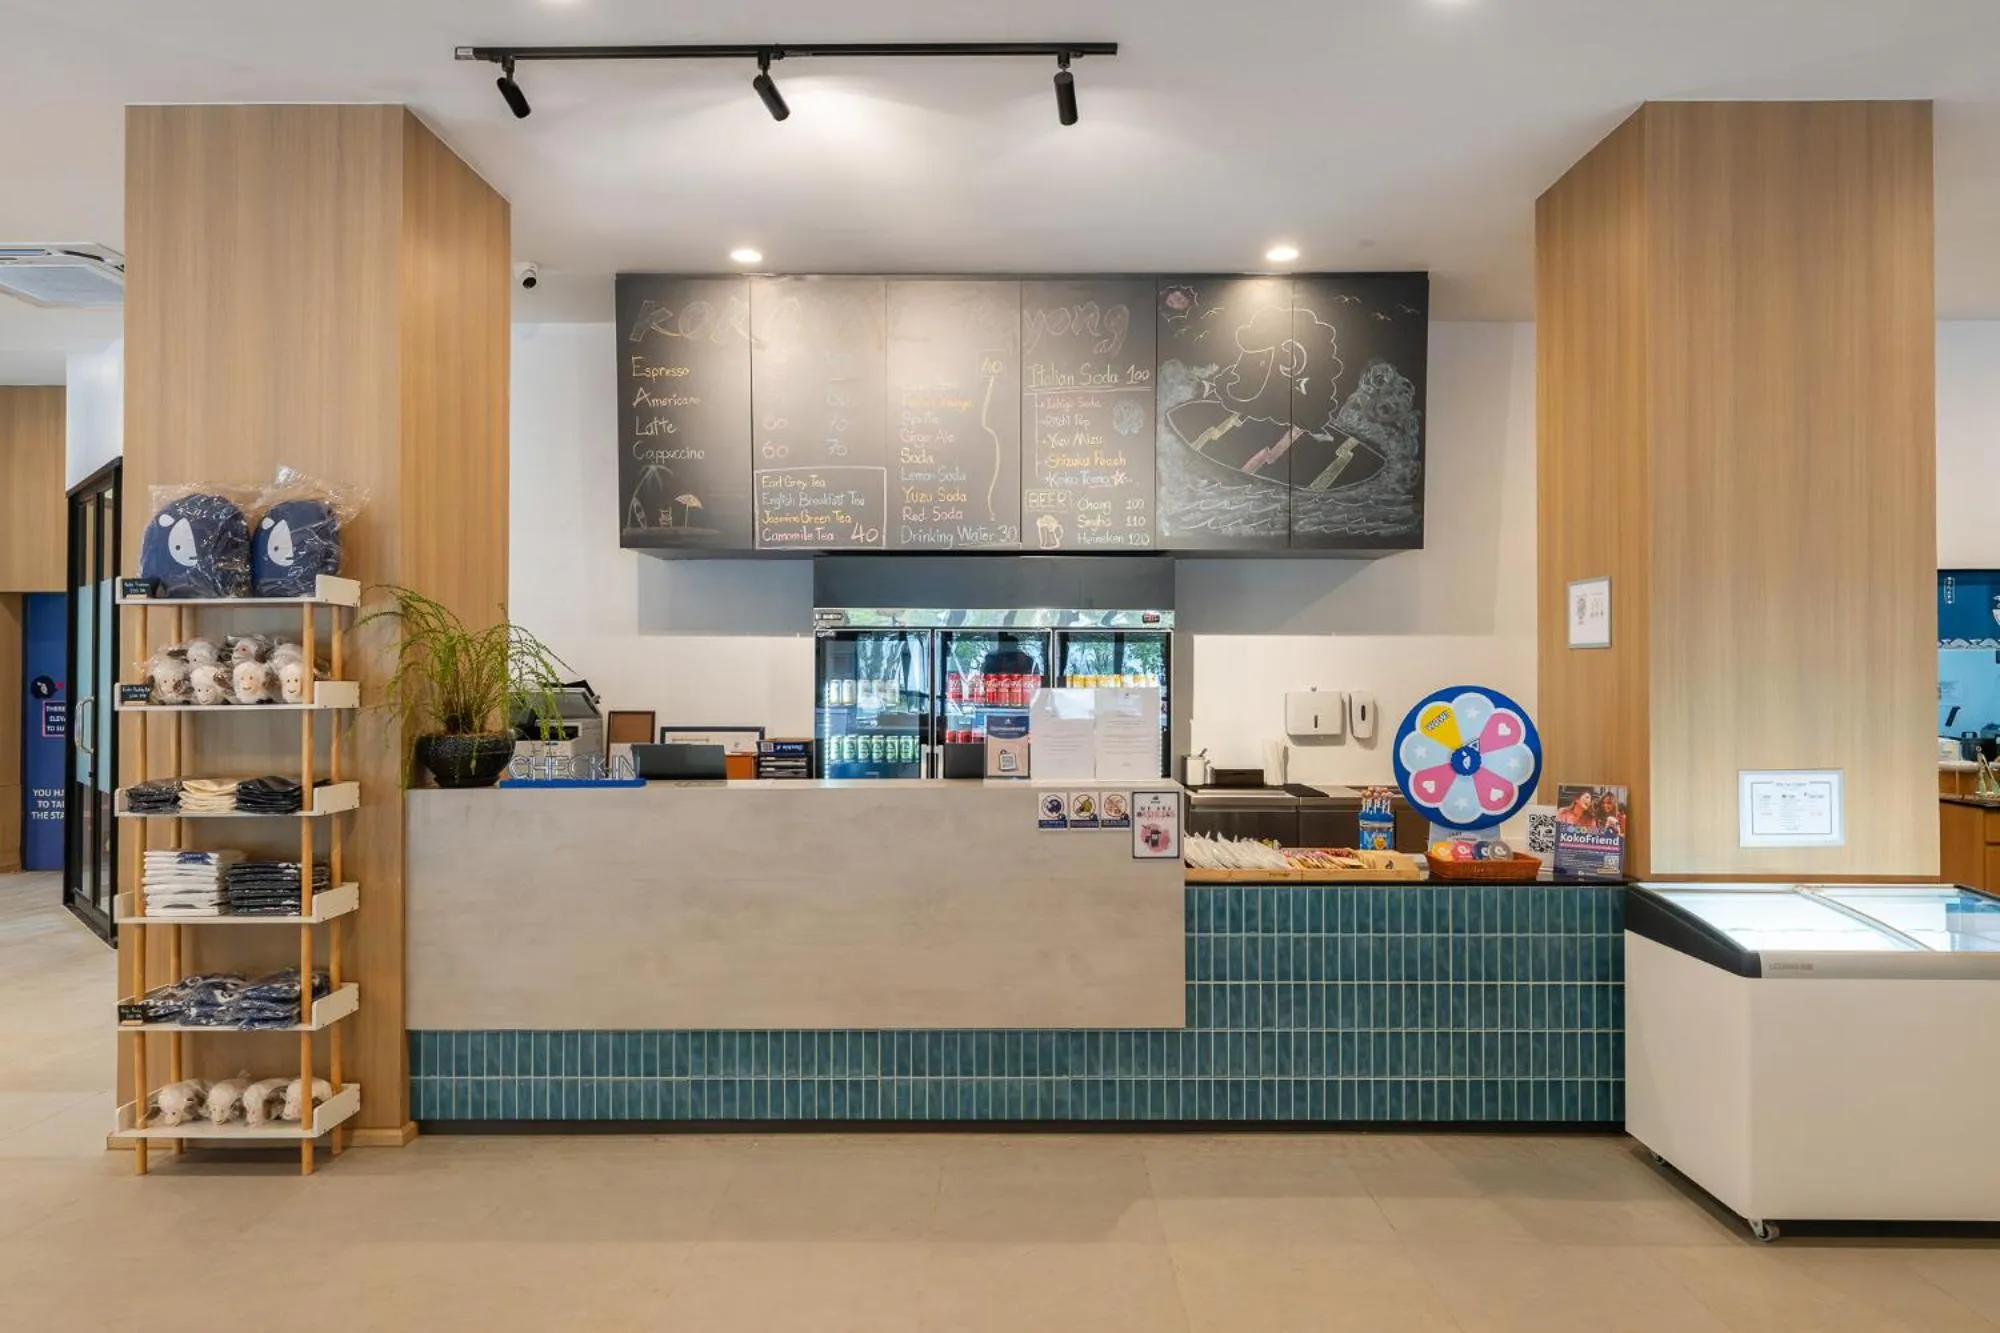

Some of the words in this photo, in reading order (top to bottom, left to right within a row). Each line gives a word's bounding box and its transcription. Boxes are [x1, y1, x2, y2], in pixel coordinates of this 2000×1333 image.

[632, 357, 691, 384] Espresso
[1080, 362, 1118, 385] Soda
[1127, 364, 1150, 384] 100
[633, 387, 701, 408] Americano
[635, 416, 678, 437] Latte
[632, 441, 706, 464] Cappuccino
[762, 440, 789, 458] 60
[900, 447, 935, 464] Soda
[762, 475, 782, 488] Earl
[809, 474, 826, 488] Tea
[848, 490, 865, 506] Tea
[937, 486, 967, 502] Soda
[1125, 498, 1145, 511] 100
[832, 509, 852, 524] Tea
[902, 506, 925, 522] Red
[933, 506, 963, 522] Soda
[1126, 516, 1146, 528] 110
[815, 526, 834, 541] Tea
[850, 521, 879, 543] 40
[900, 525, 953, 548] Drinking
[956, 525, 994, 542] Water
[998, 524, 1018, 542] 30
[1128, 533, 1150, 546] 120
[32, 788, 52, 797] YOU
[37, 800, 50, 809] TO
[31, 811, 49, 820] THE
[1560, 833, 1620, 846] KokoFriend
